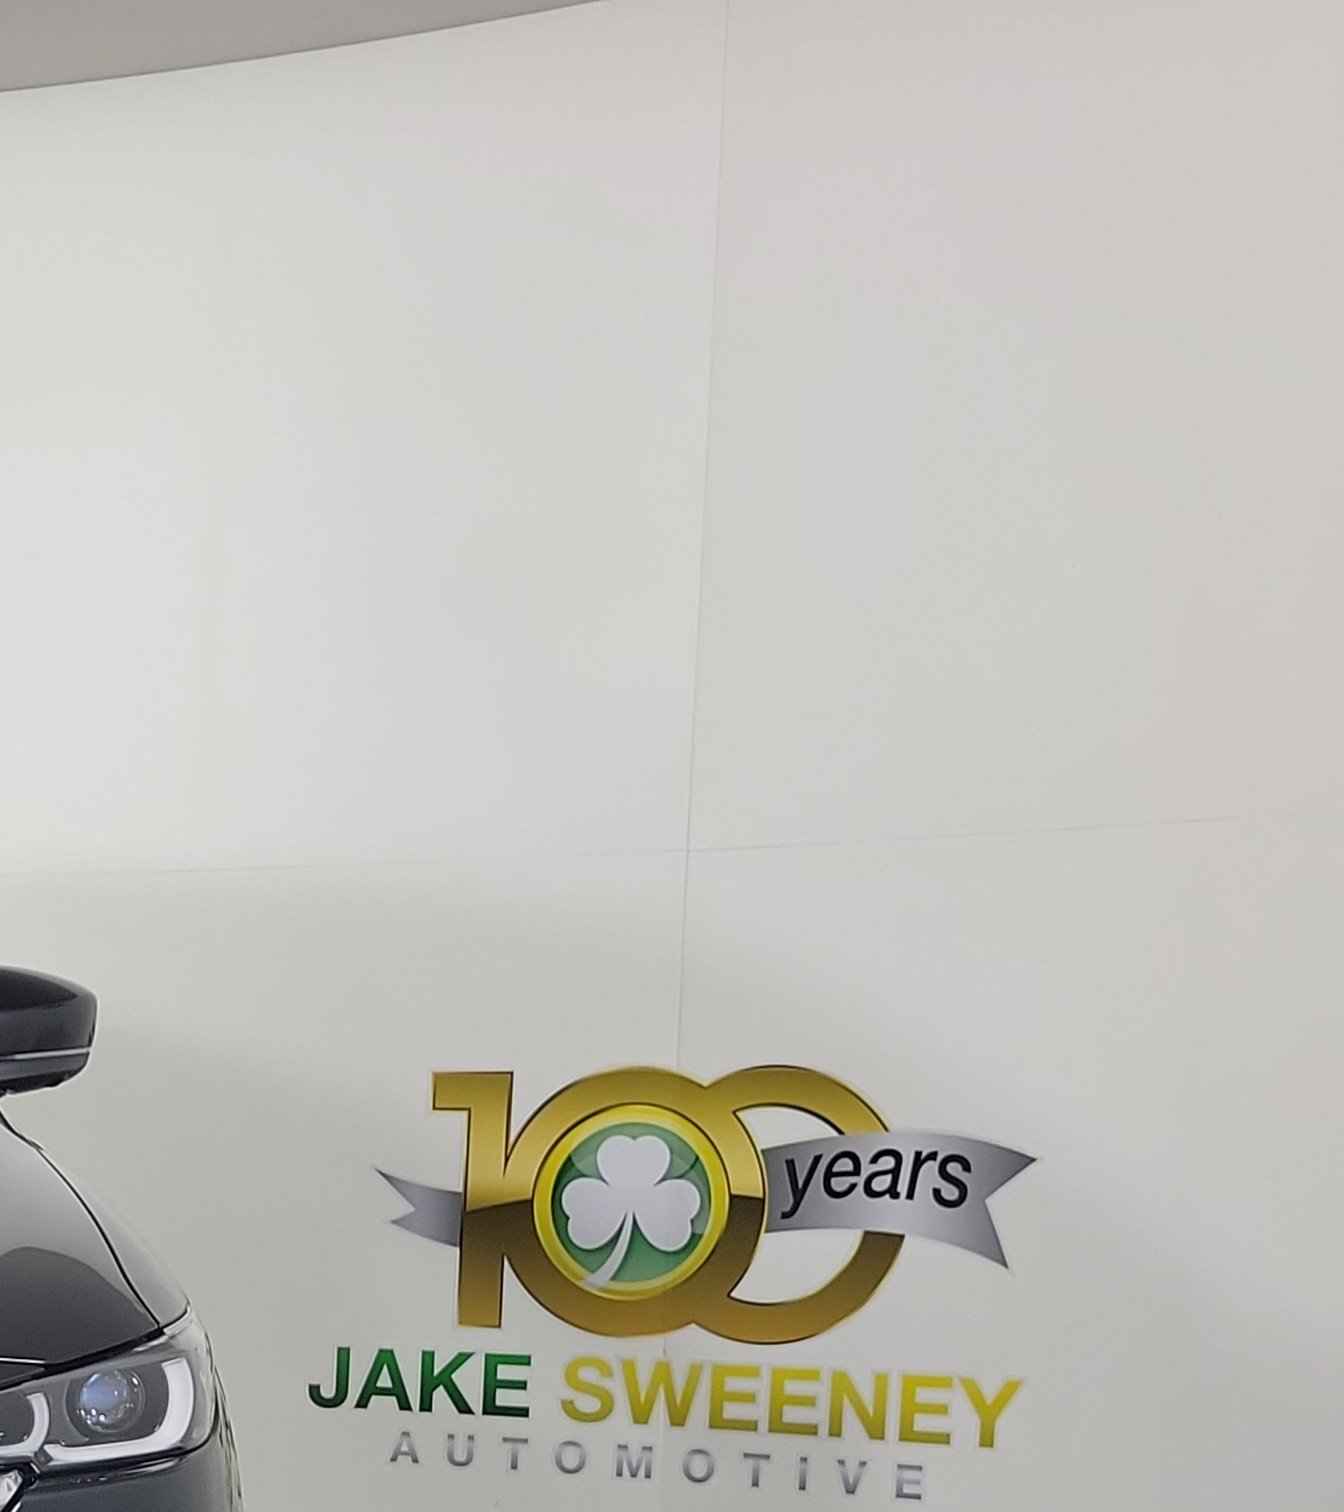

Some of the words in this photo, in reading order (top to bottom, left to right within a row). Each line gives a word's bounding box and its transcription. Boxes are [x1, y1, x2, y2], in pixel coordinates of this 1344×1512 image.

[780, 1148, 973, 1219] years
[307, 1347, 532, 1418] JAKE
[560, 1356, 1024, 1449] SWEENEY
[389, 1430, 925, 1500] AUTOMOTIVE
